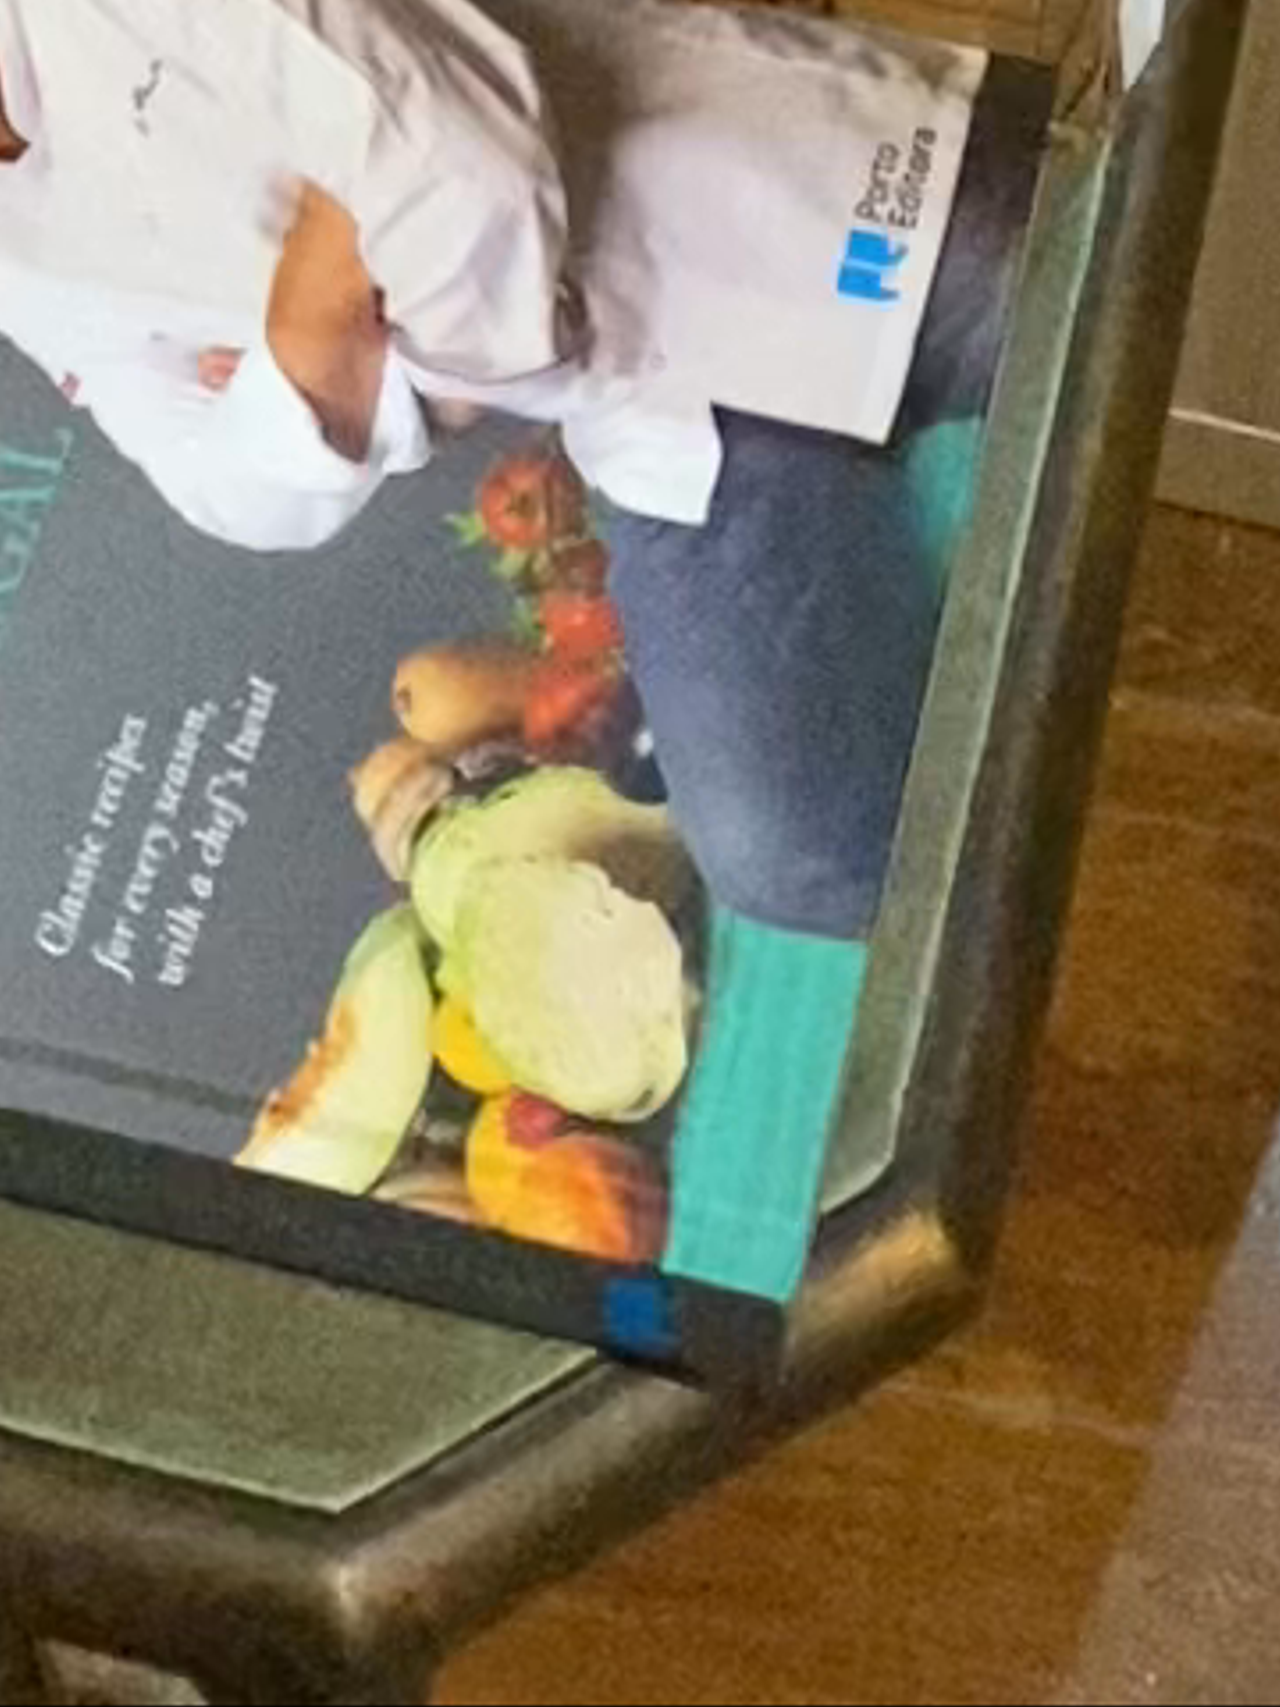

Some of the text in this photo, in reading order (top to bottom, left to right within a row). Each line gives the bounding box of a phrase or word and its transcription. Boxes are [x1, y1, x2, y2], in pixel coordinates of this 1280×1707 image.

[34, 712, 148, 957] Classic recipes
[90, 700, 219, 984] for every season,
[156, 906, 206, 987] with
[189, 872, 214, 900] a
[222, 674, 279, 764] twist
